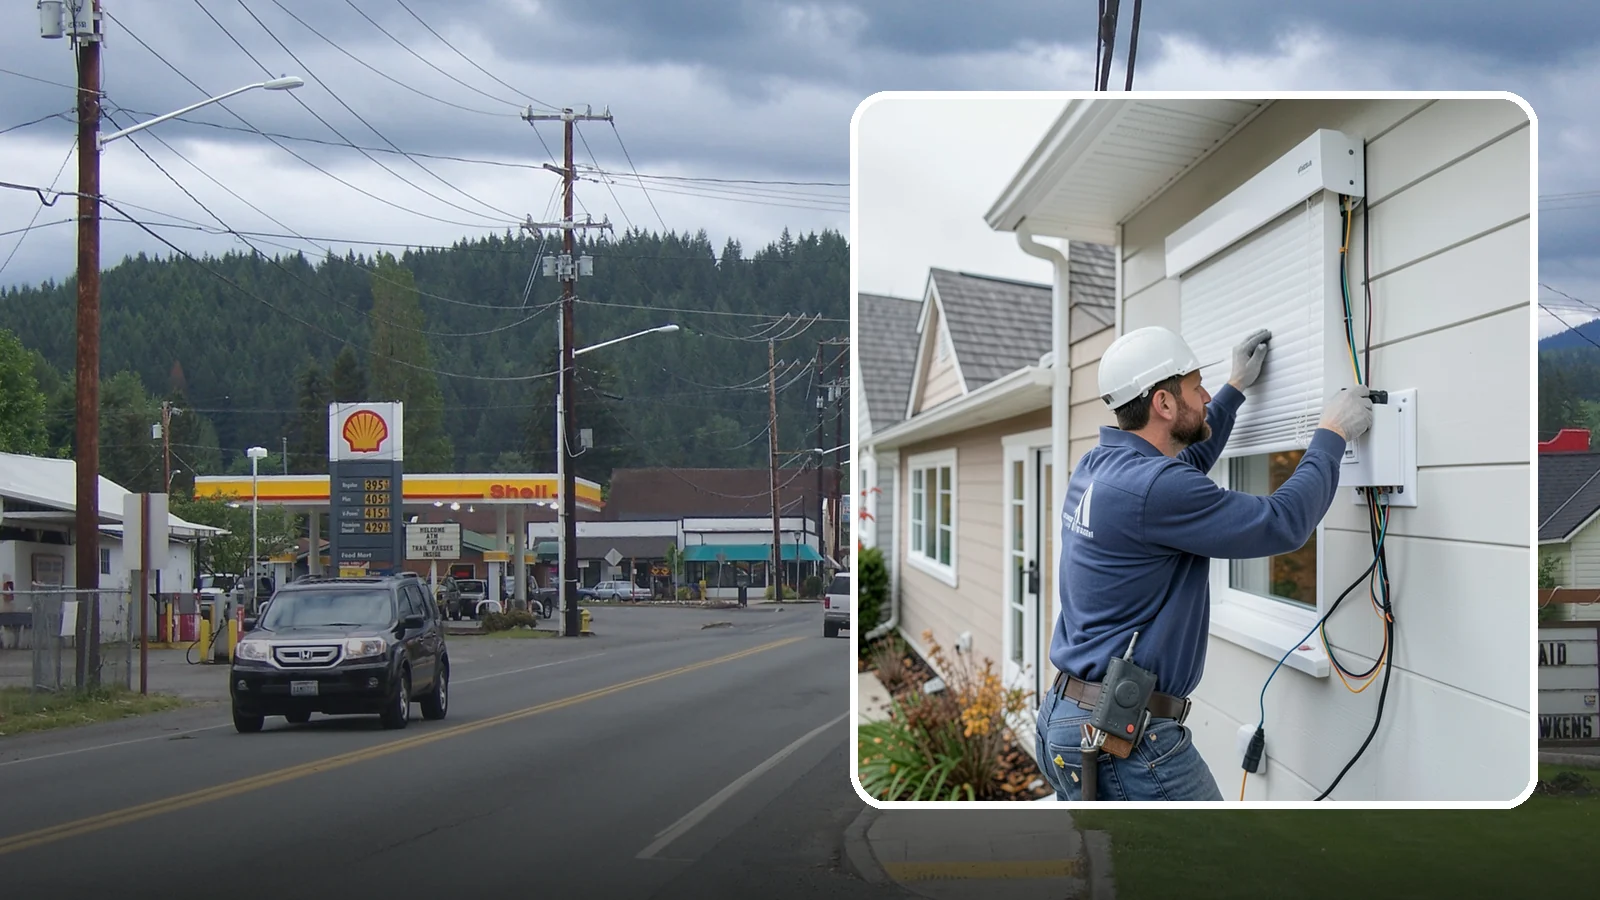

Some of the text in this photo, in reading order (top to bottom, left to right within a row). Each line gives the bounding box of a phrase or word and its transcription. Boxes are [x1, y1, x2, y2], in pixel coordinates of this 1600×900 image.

[365, 480, 384, 490] 395
[490, 484, 547, 499] Shell
[365, 494, 384, 504] 405
[365, 508, 384, 518] 415
[365, 522, 384, 532] 429
